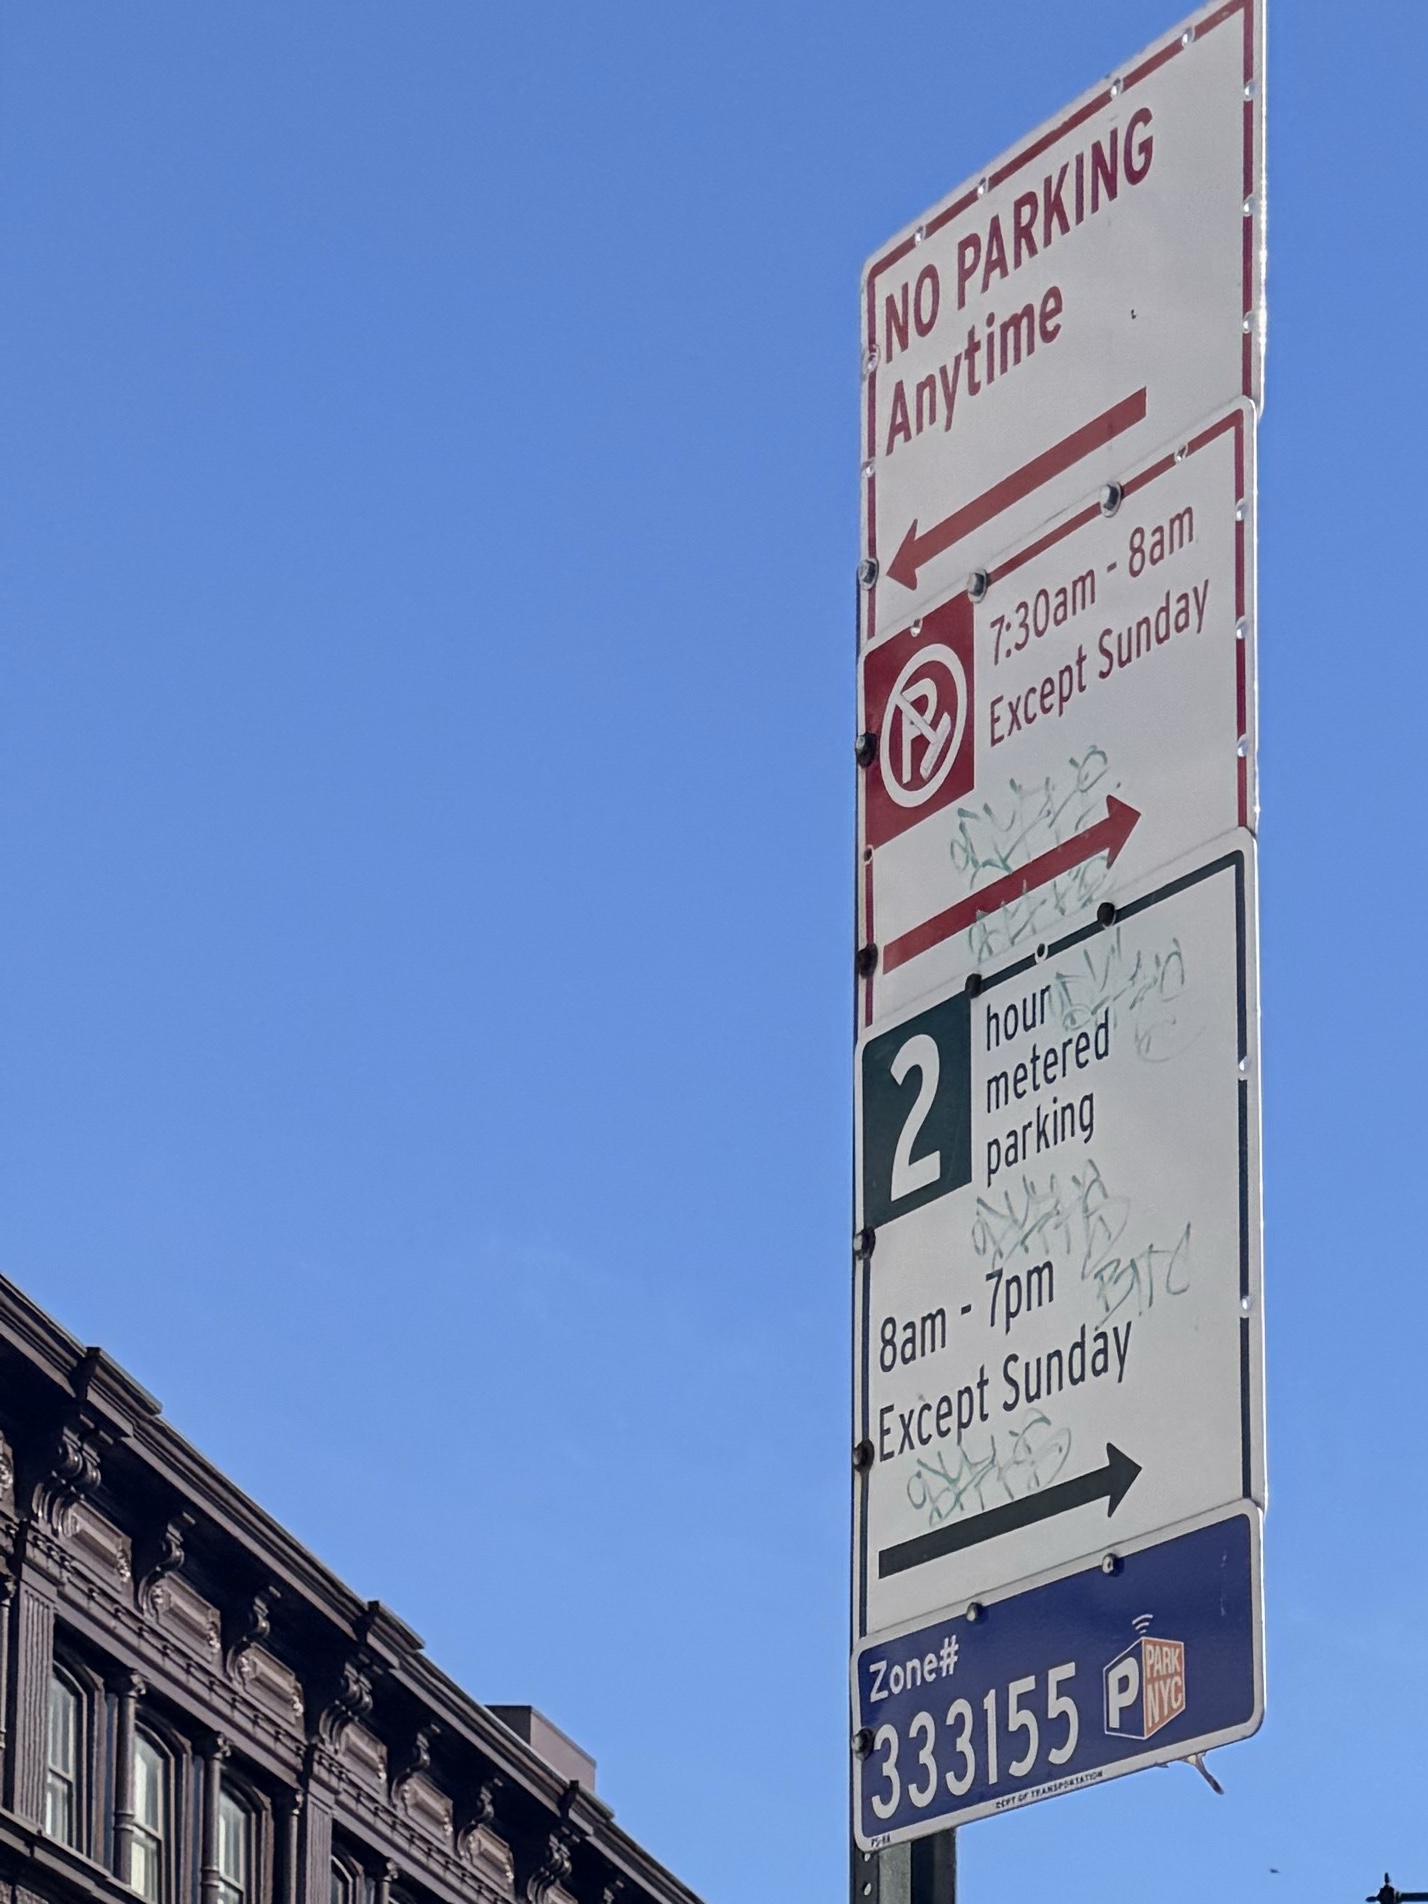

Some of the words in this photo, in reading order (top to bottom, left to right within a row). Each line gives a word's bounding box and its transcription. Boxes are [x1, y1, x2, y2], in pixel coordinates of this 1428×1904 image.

[883, 264, 941, 364] NO
[956, 105, 1156, 293] PARKING
[884, 283, 1064, 456] Anytime
[990, 568, 1097, 668] 7:30am
[1128, 502, 1195, 577] 8am
[990, 648, 1089, 746] Except
[1098, 577, 1209, 678] Sunday
[986, 983, 1051, 1052] hour
[986, 1007, 1111, 1113] metered
[890, 1033, 941, 1201] 2
[986, 1088, 1095, 1182] parking
[880, 1312, 947, 1374] 8am
[986, 1260, 1055, 1334] 7pm
[880, 1362, 990, 1464] Except
[1001, 1319, 1132, 1410] Sunday
[869, 1638, 959, 1703] Zone#
[1145, 1642, 1181, 1681] PARK
[1145, 1675, 1185, 1725] NYC
[872, 1660, 1078, 1820] 333155
[1031, 1769, 1104, 1798] TRANSPORTATION
